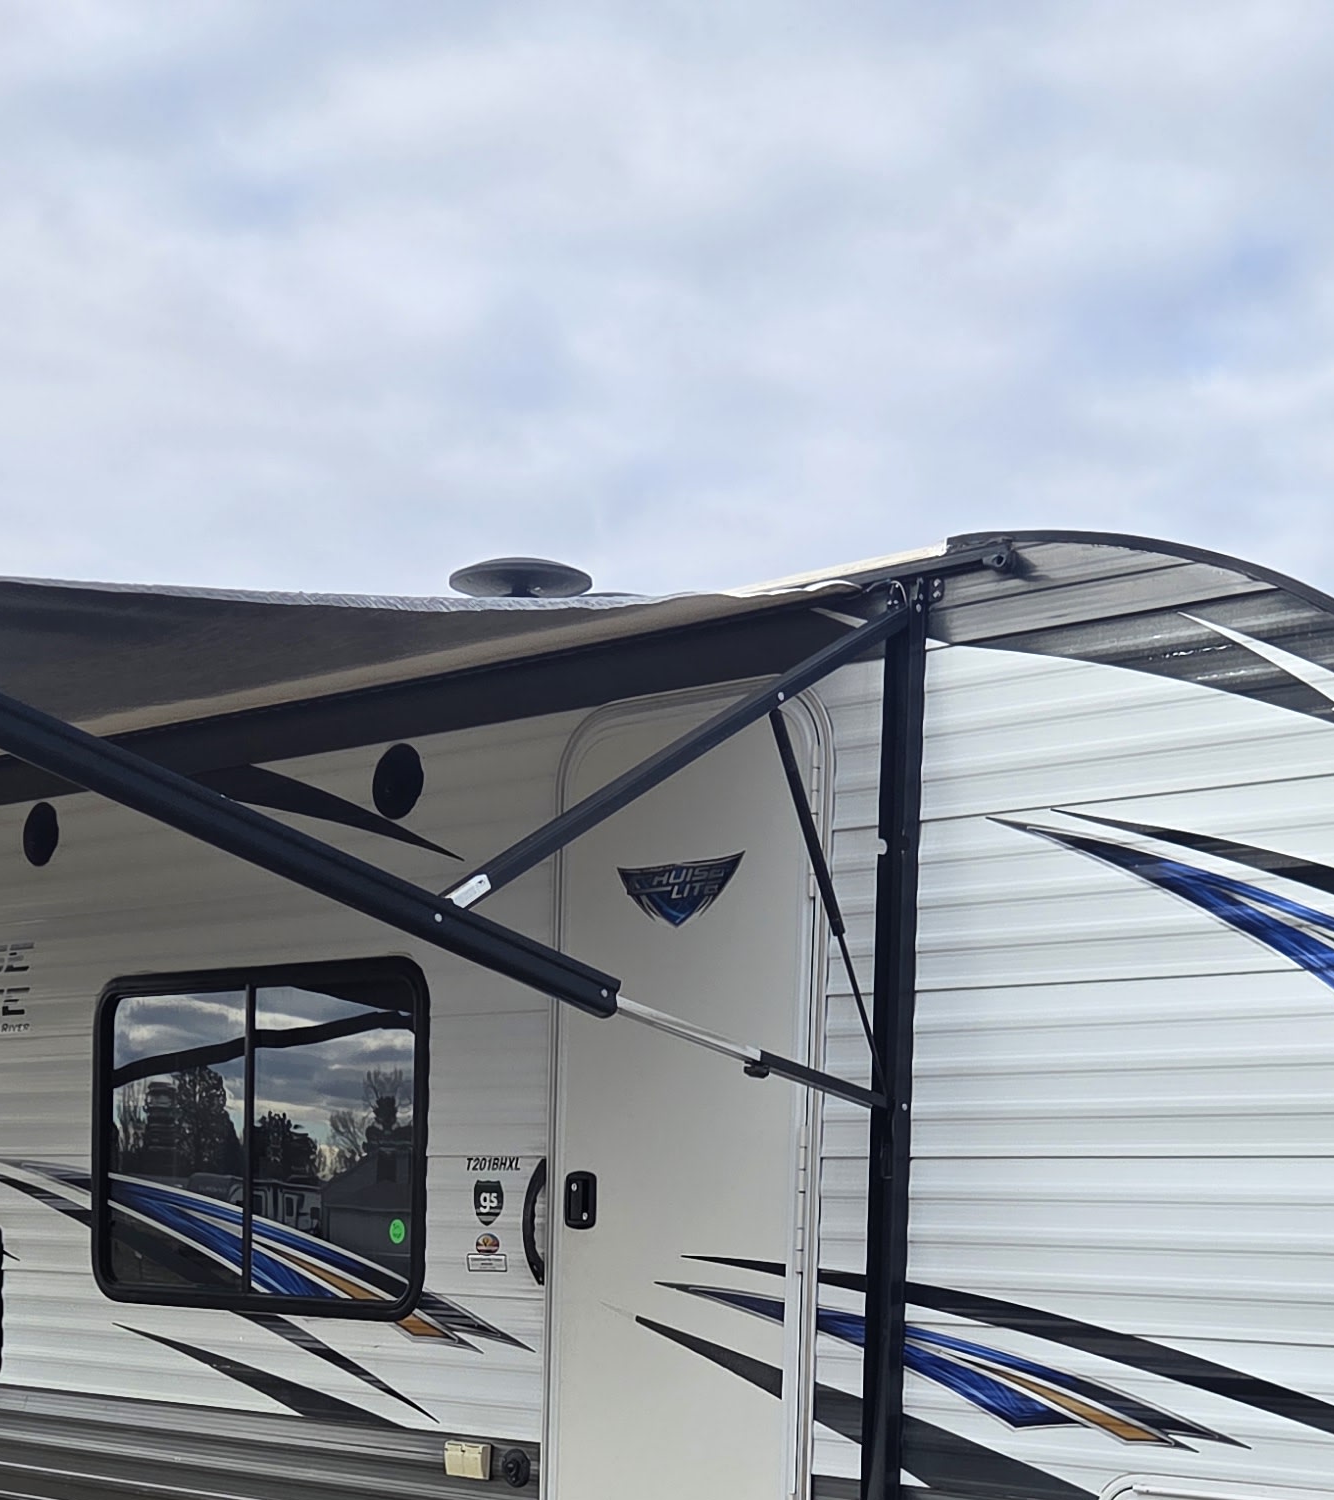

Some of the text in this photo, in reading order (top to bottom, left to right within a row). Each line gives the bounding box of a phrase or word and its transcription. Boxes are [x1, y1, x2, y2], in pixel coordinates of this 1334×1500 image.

[0, 1022, 30, 1034] RIVER
[466, 1157, 521, 1172] T201BHXL
[479, 1192, 498, 1213] gs
